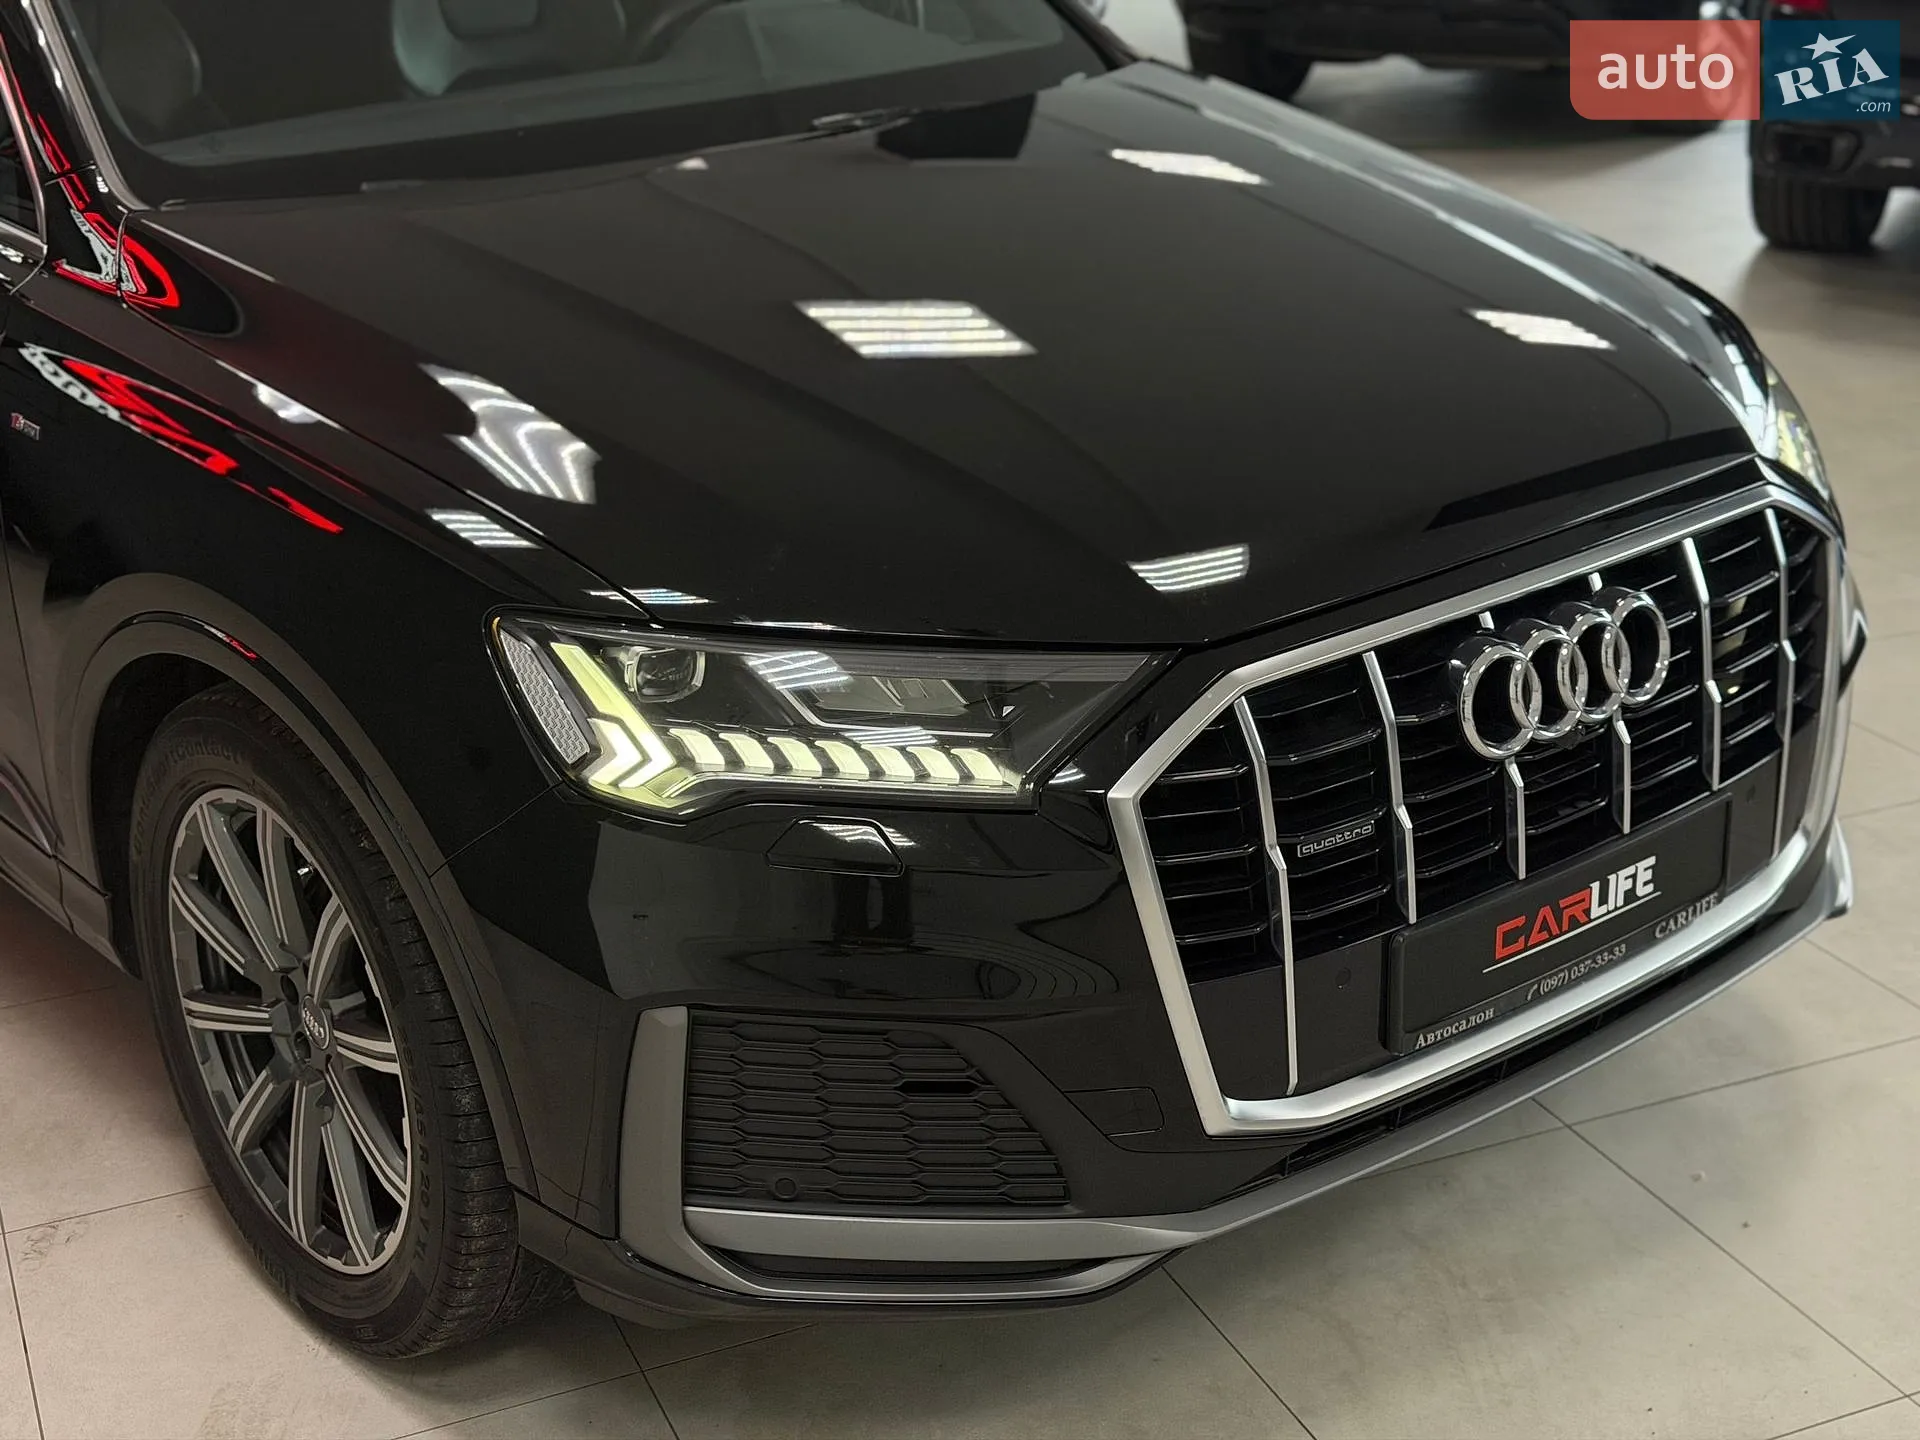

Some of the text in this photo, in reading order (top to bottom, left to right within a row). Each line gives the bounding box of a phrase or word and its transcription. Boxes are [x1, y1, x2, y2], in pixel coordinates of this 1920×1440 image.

[1301, 824, 1373, 855] quattro
[1494, 854, 1657, 961] CARLIFE
[1654, 891, 1719, 939] CARLIFE
[1539, 942, 1627, 996] (097) 037-33-33
[1414, 1006, 1495, 1050] Автосалон
